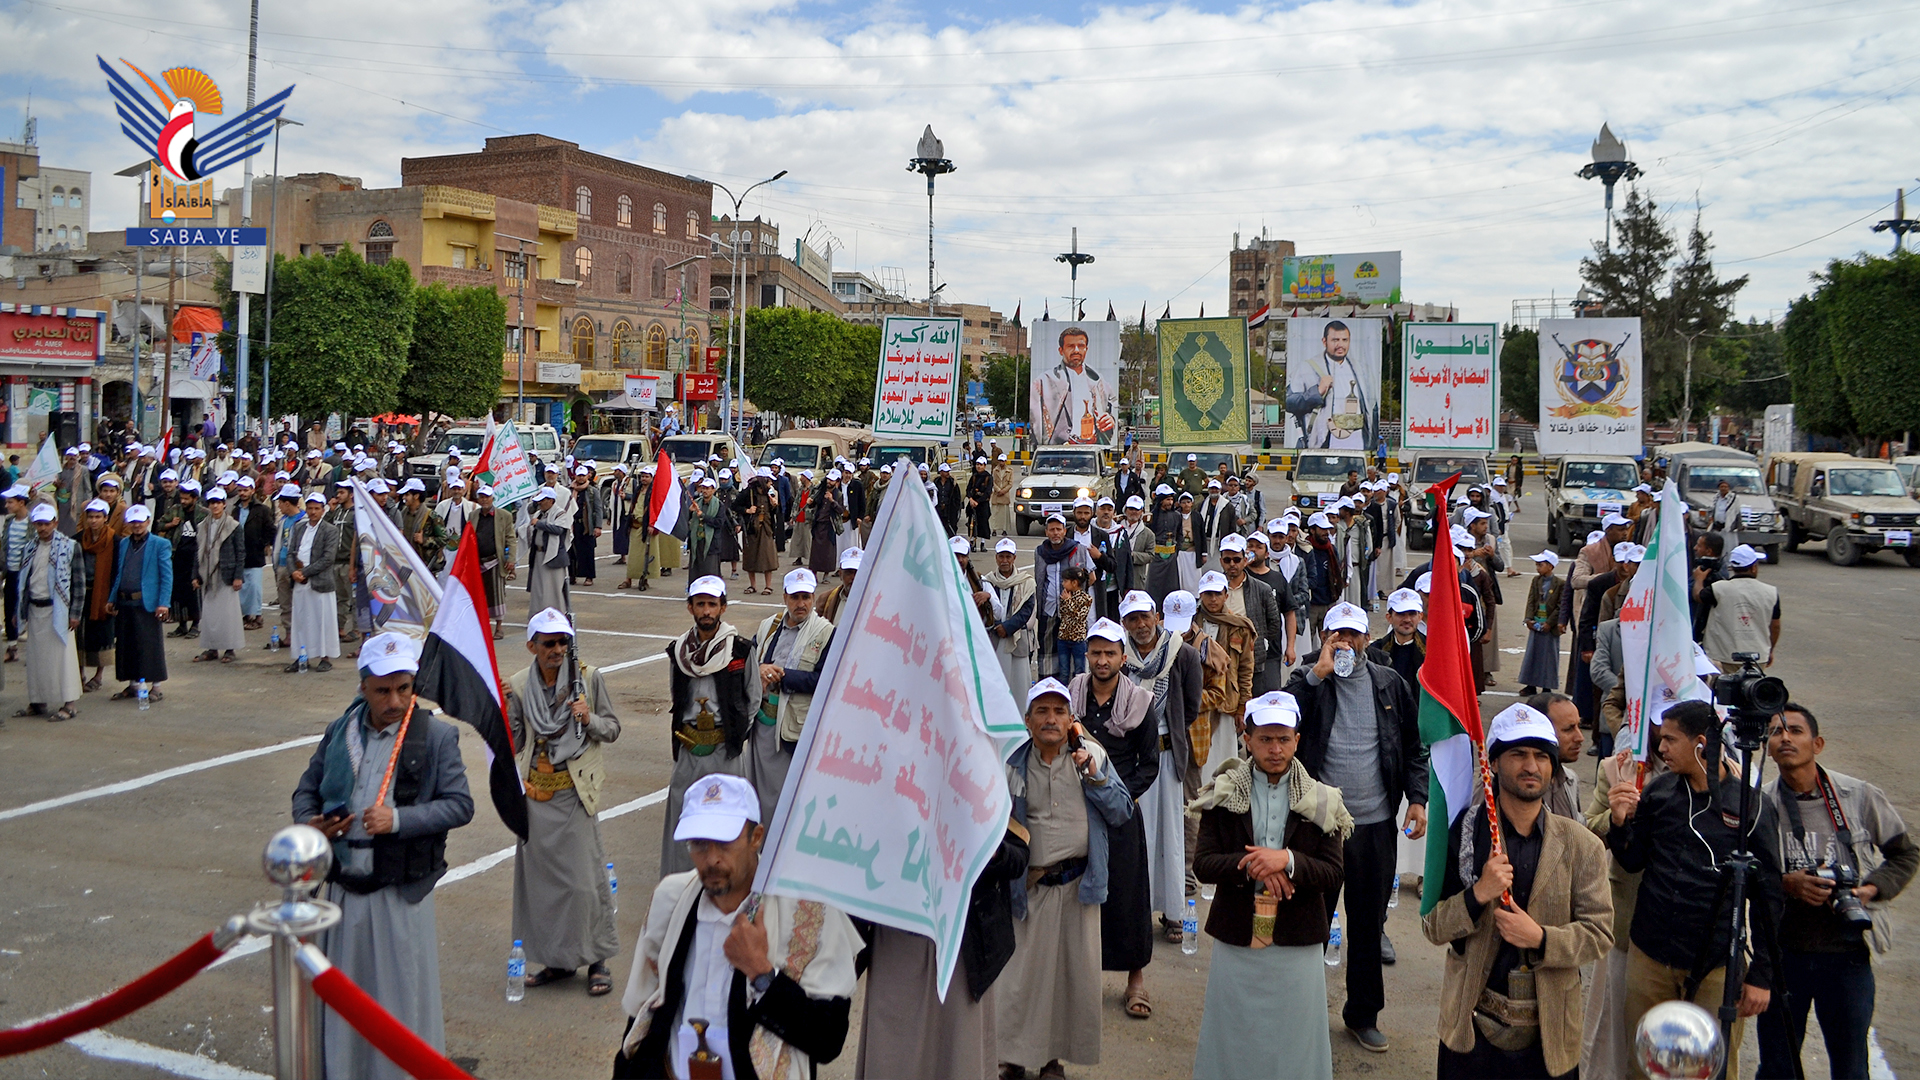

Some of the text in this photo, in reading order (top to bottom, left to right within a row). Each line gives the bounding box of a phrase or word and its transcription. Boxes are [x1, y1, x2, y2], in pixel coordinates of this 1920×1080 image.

[67, 320, 94, 328] مجموعة
[13, 326, 70, 343] العامري
[888, 322, 956, 348] الله أكبر
[1410, 333, 1489, 360] قاطعوا
[886, 347, 954, 366] الموت لأمريكا
[884, 369, 952, 386] الموت لإسرائيل
[1409, 363, 1489, 388] البضائع الأمريكية
[881, 389, 950, 405] اللعنة على اليهود
[1444, 392, 1451, 409] و
[879, 407, 949, 430] النصر للإسلام
[514, 463, 530, 476] اللعنة
[516, 475, 533, 494] النصر
[1832, 808, 1845, 827] EOS
